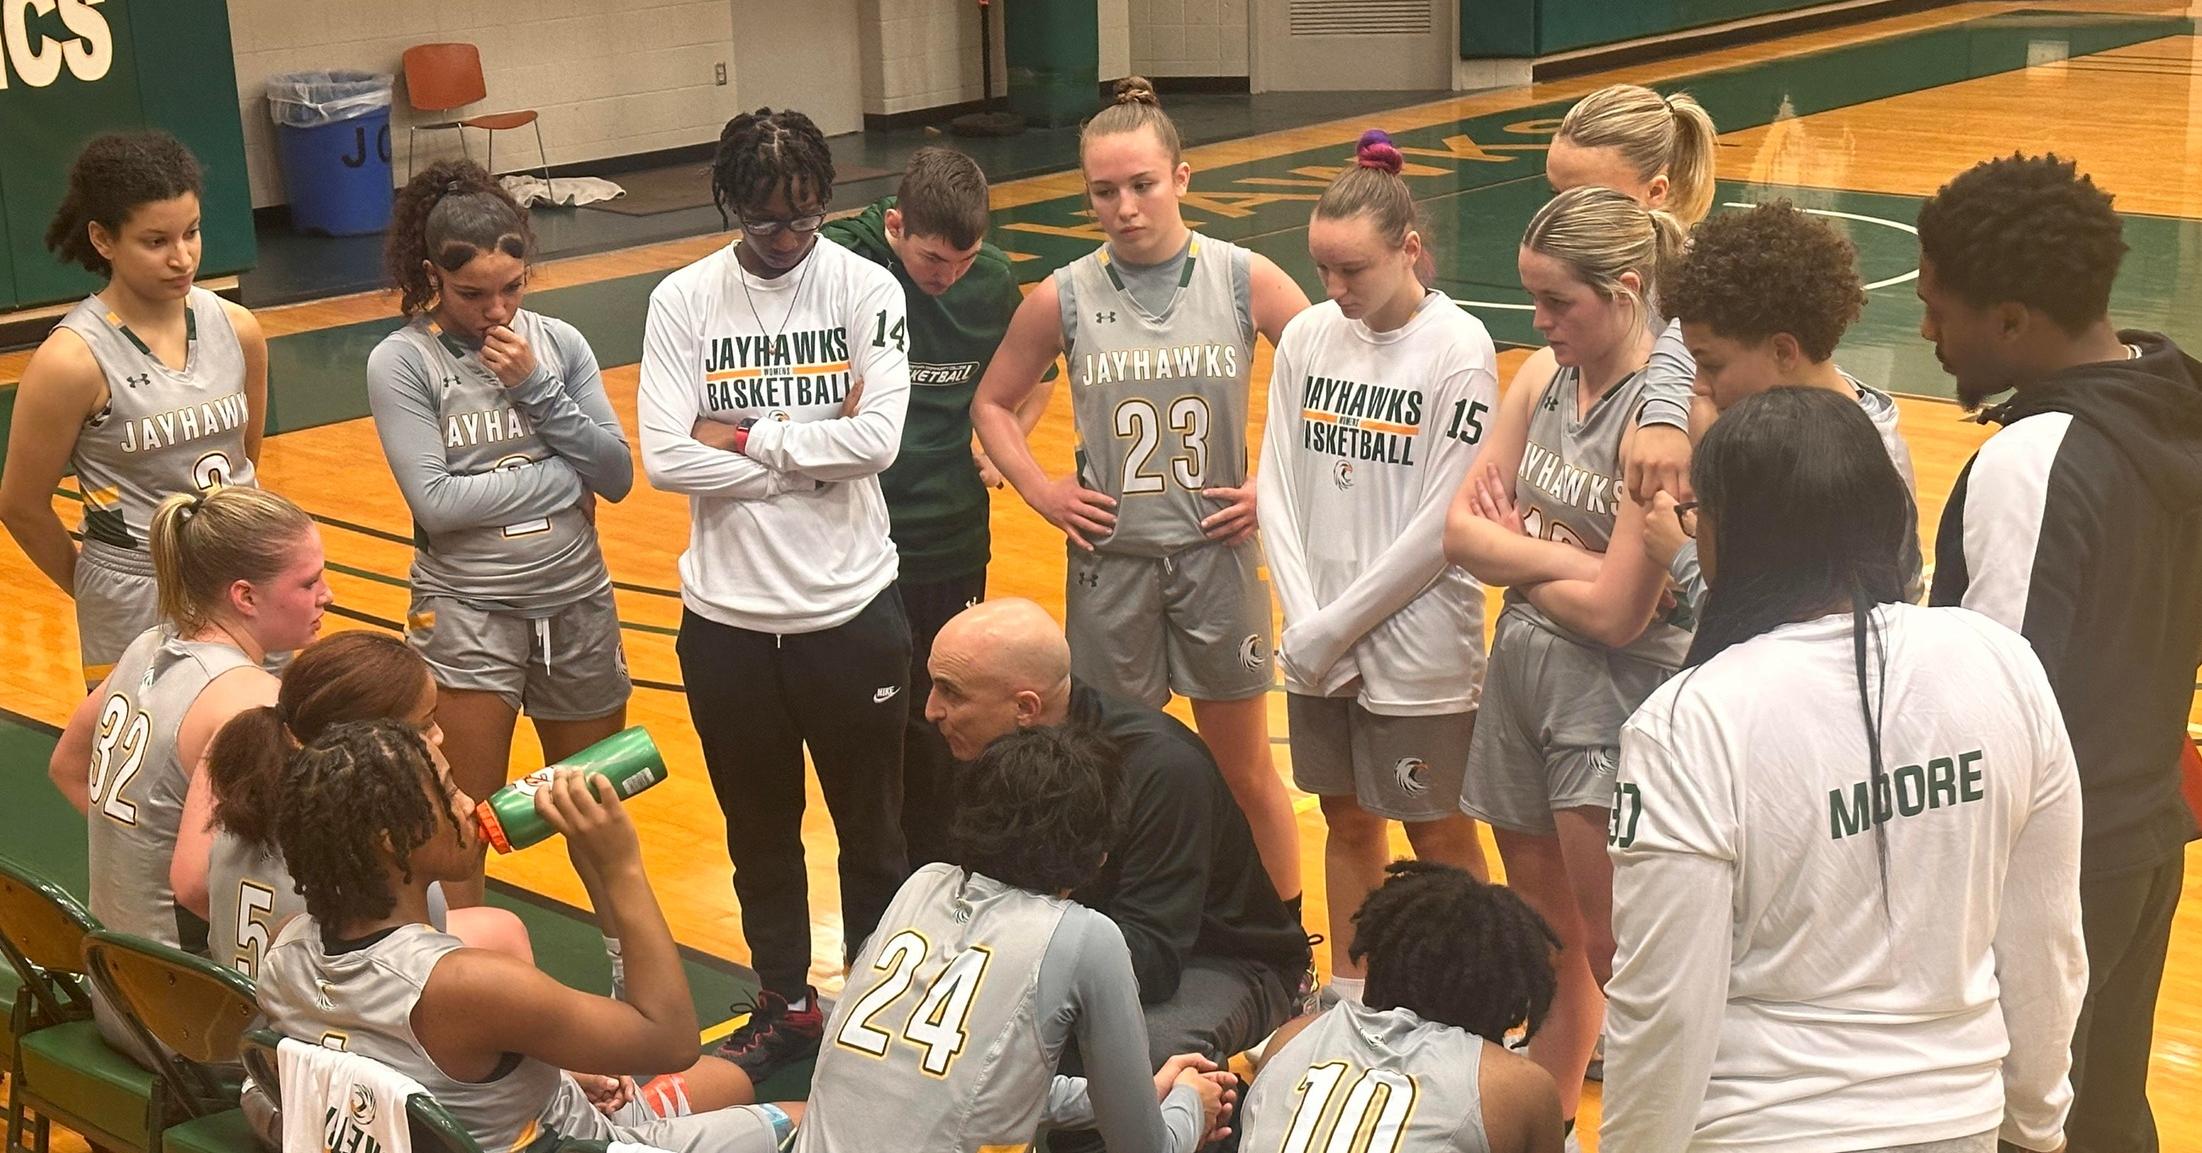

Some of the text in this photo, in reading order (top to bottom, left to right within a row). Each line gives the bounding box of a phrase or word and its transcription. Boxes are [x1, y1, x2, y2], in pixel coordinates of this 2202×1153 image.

[0, 0, 112, 89] CS
[705, 326, 850, 373] JAYHAWKS
[872, 309, 905, 353] 14
[1082, 343, 1238, 387] JAYHAWKS
[909, 364, 972, 383] KETBALL
[446, 406, 535, 448] AYHA
[1113, 393, 1211, 496] 23
[1303, 420, 1414, 466] ASKETBALL
[1446, 398, 1489, 446] 15
[89, 690, 152, 827] 32
[1828, 749, 1985, 840] MOORE
[235, 878, 276, 981] 5
[835, 926, 993, 1080] 24
[1279, 1057, 1422, 1153] 10
